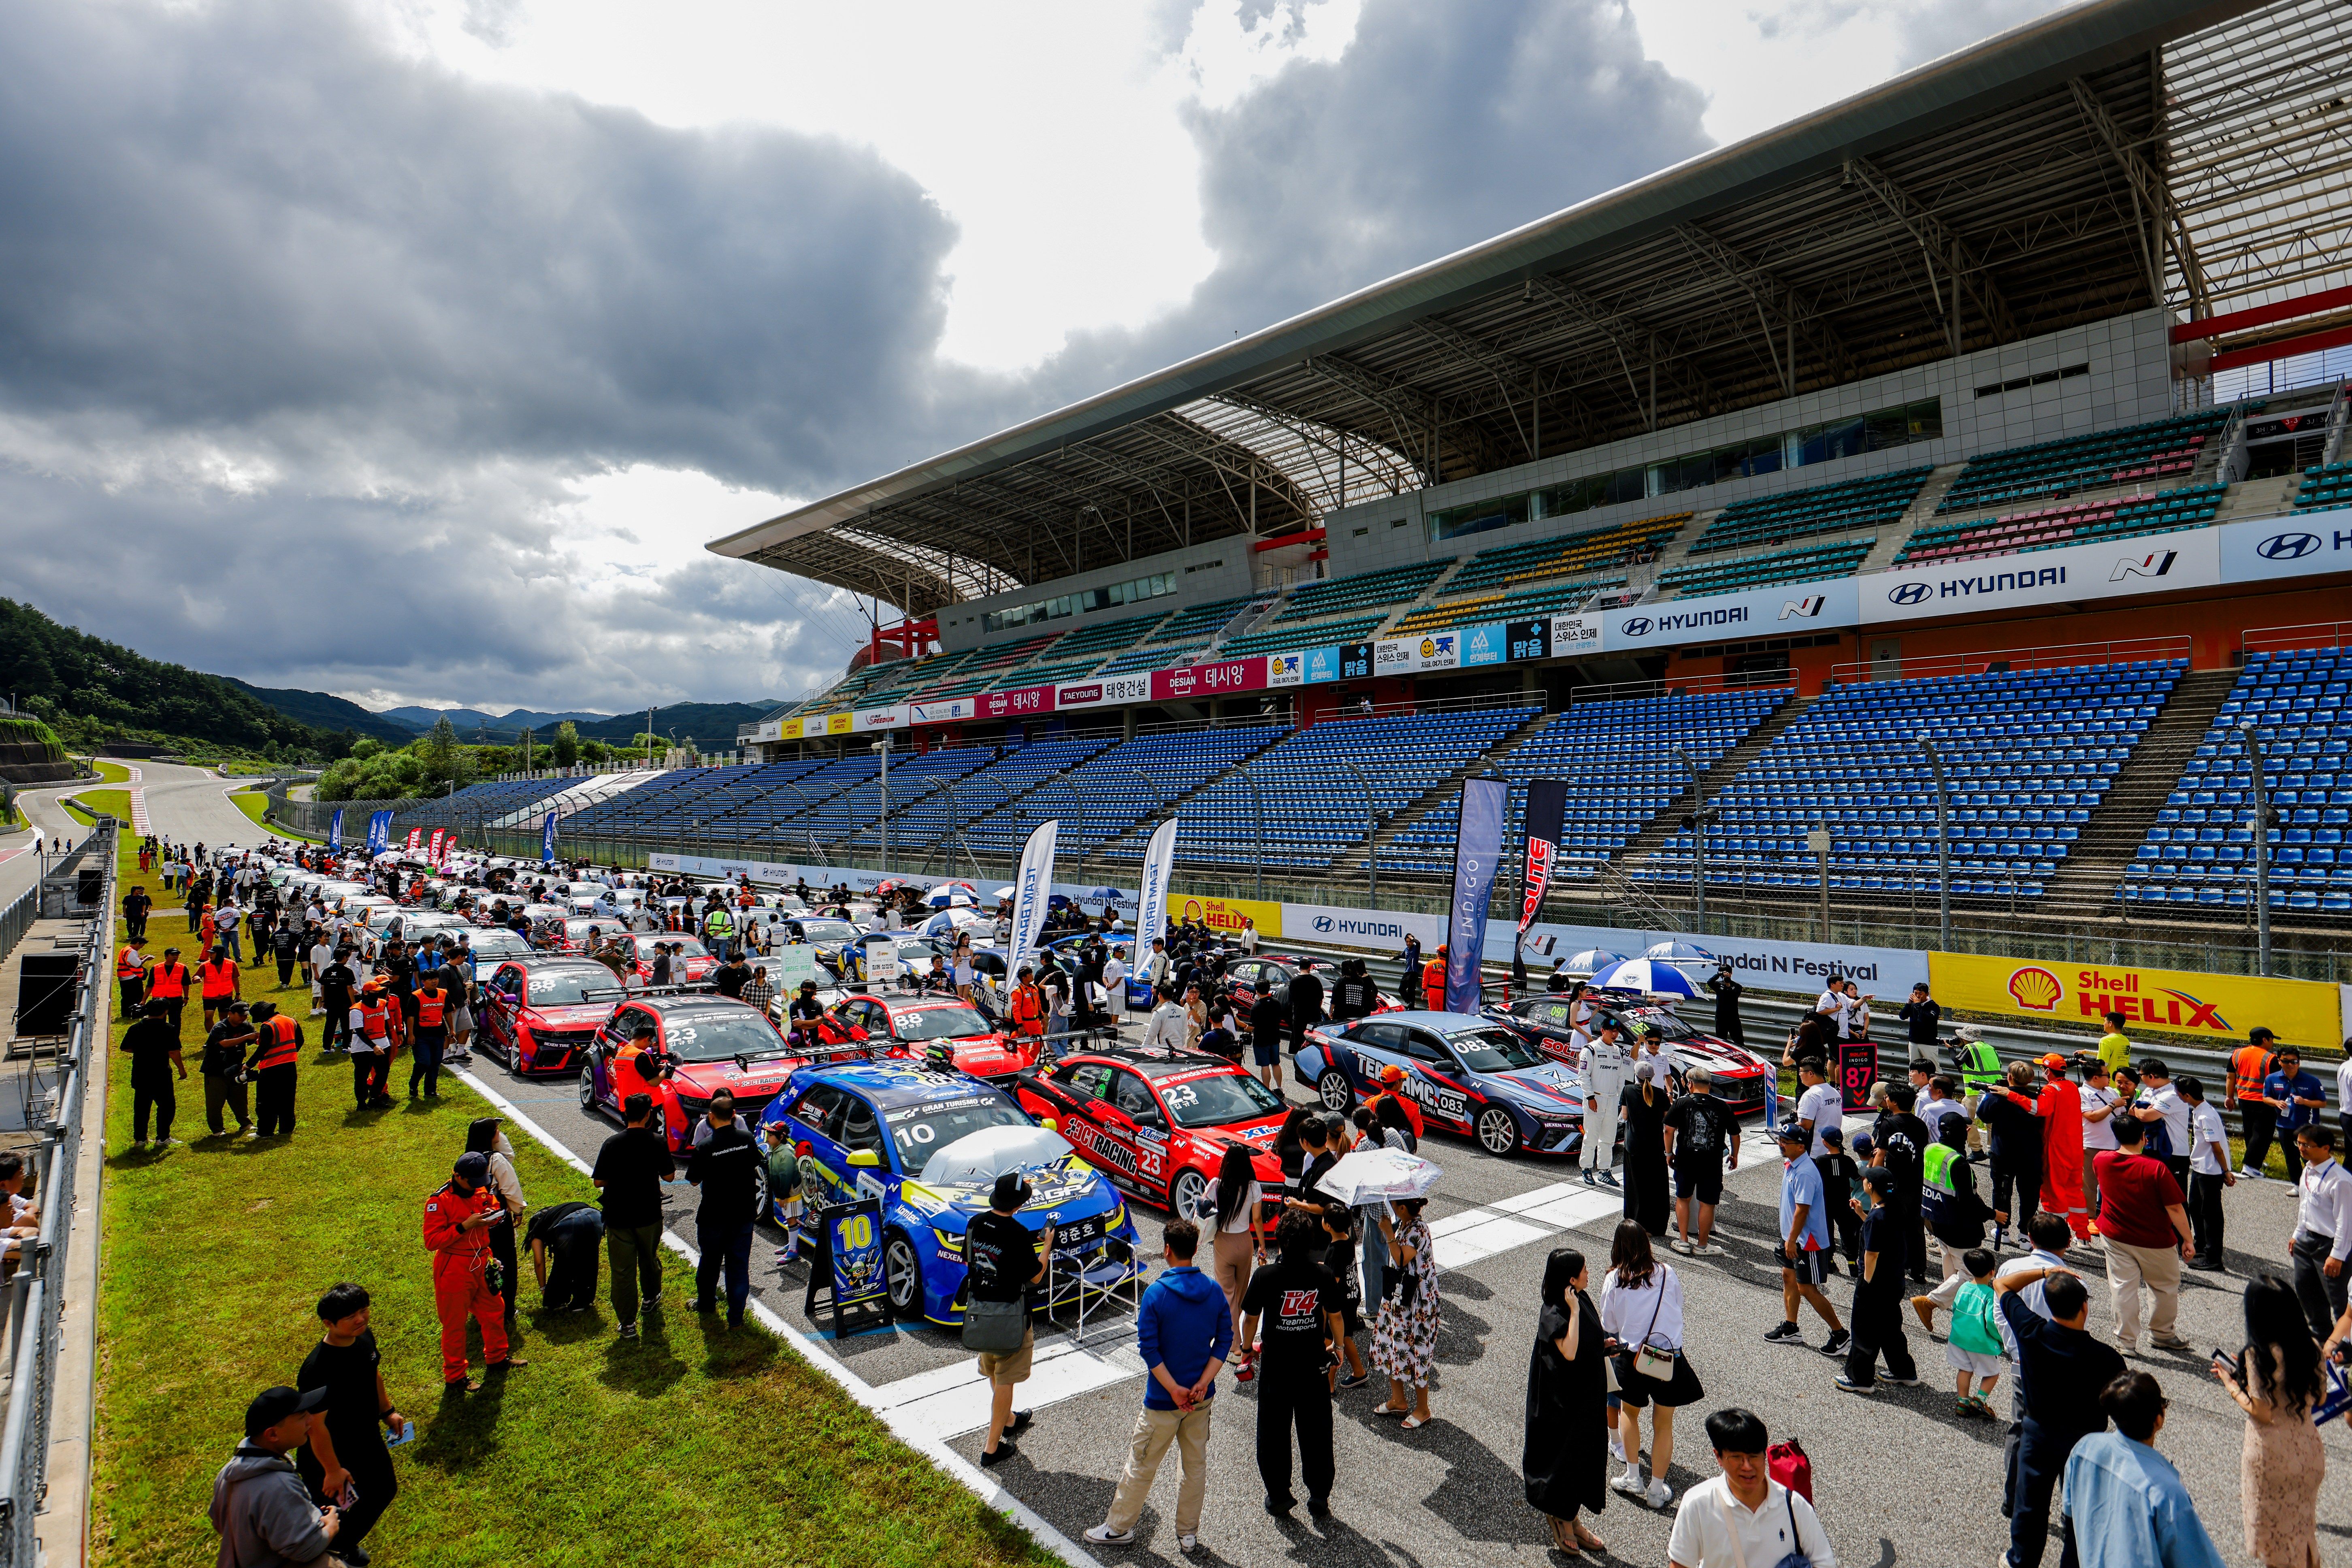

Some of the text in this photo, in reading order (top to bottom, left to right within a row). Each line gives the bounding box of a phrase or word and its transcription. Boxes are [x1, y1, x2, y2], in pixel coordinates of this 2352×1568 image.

[1941, 567, 2066, 598] HYUNDAI
[1555, 620, 1582, 631] 대한민국
[1660, 607, 1748, 631] HYUNDAI
[1555, 628, 1597, 642] 스위스 인제
[1377, 644, 1398, 653] 대한민국
[1513, 639, 1542, 658] 맑음
[1377, 652, 1409, 664] 스위스 인제
[1470, 652, 1497, 663] 인제부터
[1311, 670, 1332, 680] 인제부터
[1345, 660, 1367, 677] 맑음
[1170, 676, 1196, 688] DESIAN
[1206, 665, 1244, 688] 데시앙
[1063, 689, 1098, 700] TAEYOUNG
[1107, 679, 1146, 699] 태영건설
[989, 699, 1007, 709] DESIAN
[1014, 691, 1040, 709] 데시앙
[952, 706, 960, 717] 14
[770, 869, 788, 878] HYUNDAI
[857, 876, 876, 886] Hyundai
[1074, 894, 1111, 908] Hyundai N
[1461, 859, 1479, 937] INDIGO
[1477, 881, 1489, 918] RACING
[1206, 901, 1225, 912] Shell
[1206, 911, 1248, 929] HELIX
[1339, 920, 1402, 937] HYUNDAI
[1772, 956, 1878, 981] N Festival
[528, 980, 556, 991] 88
[2079, 971, 2138, 993] Shell
[1551, 1006, 1567, 1018] 097
[2077, 992, 2227, 1031] HELIX
[894, 1013, 923, 1026] 88
[1551, 1017, 1563, 1025] Park
[665, 1027, 697, 1043] 23
[1456, 1029, 1477, 1038] Hyundai
[1454, 1040, 1491, 1054] 083
[1169, 1070, 1199, 1082] Hyundai
[1207, 1067, 1234, 1076] Festival
[1846, 1067, 1872, 1088] 87
[1161, 1084, 1197, 1105] 23
[1824, 1097, 1835, 1106] TEAM
[802, 1101, 823, 1118] NEXEN TIRE
[922, 1098, 979, 1112] GRAN TURISMO
[1421, 1102, 1436, 1116] TEAM
[1440, 1096, 1463, 1113] 083
[895, 1124, 935, 1147] 10
[1139, 1125, 1163, 1142] XTeer
[1155, 1131, 1168, 1139] HYUNDAI
[1138, 1140, 1150, 1148] Hyundai
[712, 1148, 729, 1157] Hyundai
[1193, 1147, 1205, 1157] logitech
[1141, 1150, 1161, 1175] 23
[860, 1175, 871, 1184] Hyundai
[1139, 1171, 1165, 1187] KUMHO TIRE
[1044, 1183, 1082, 1200] GP
[1922, 1186, 1943, 1202] EDIA
[837, 1214, 872, 1252] 10
[1059, 1223, 1095, 1244] 장준호
[1276, 1323, 1317, 1332] Motorsports
[1281, 1317, 1315, 1325] Team04
